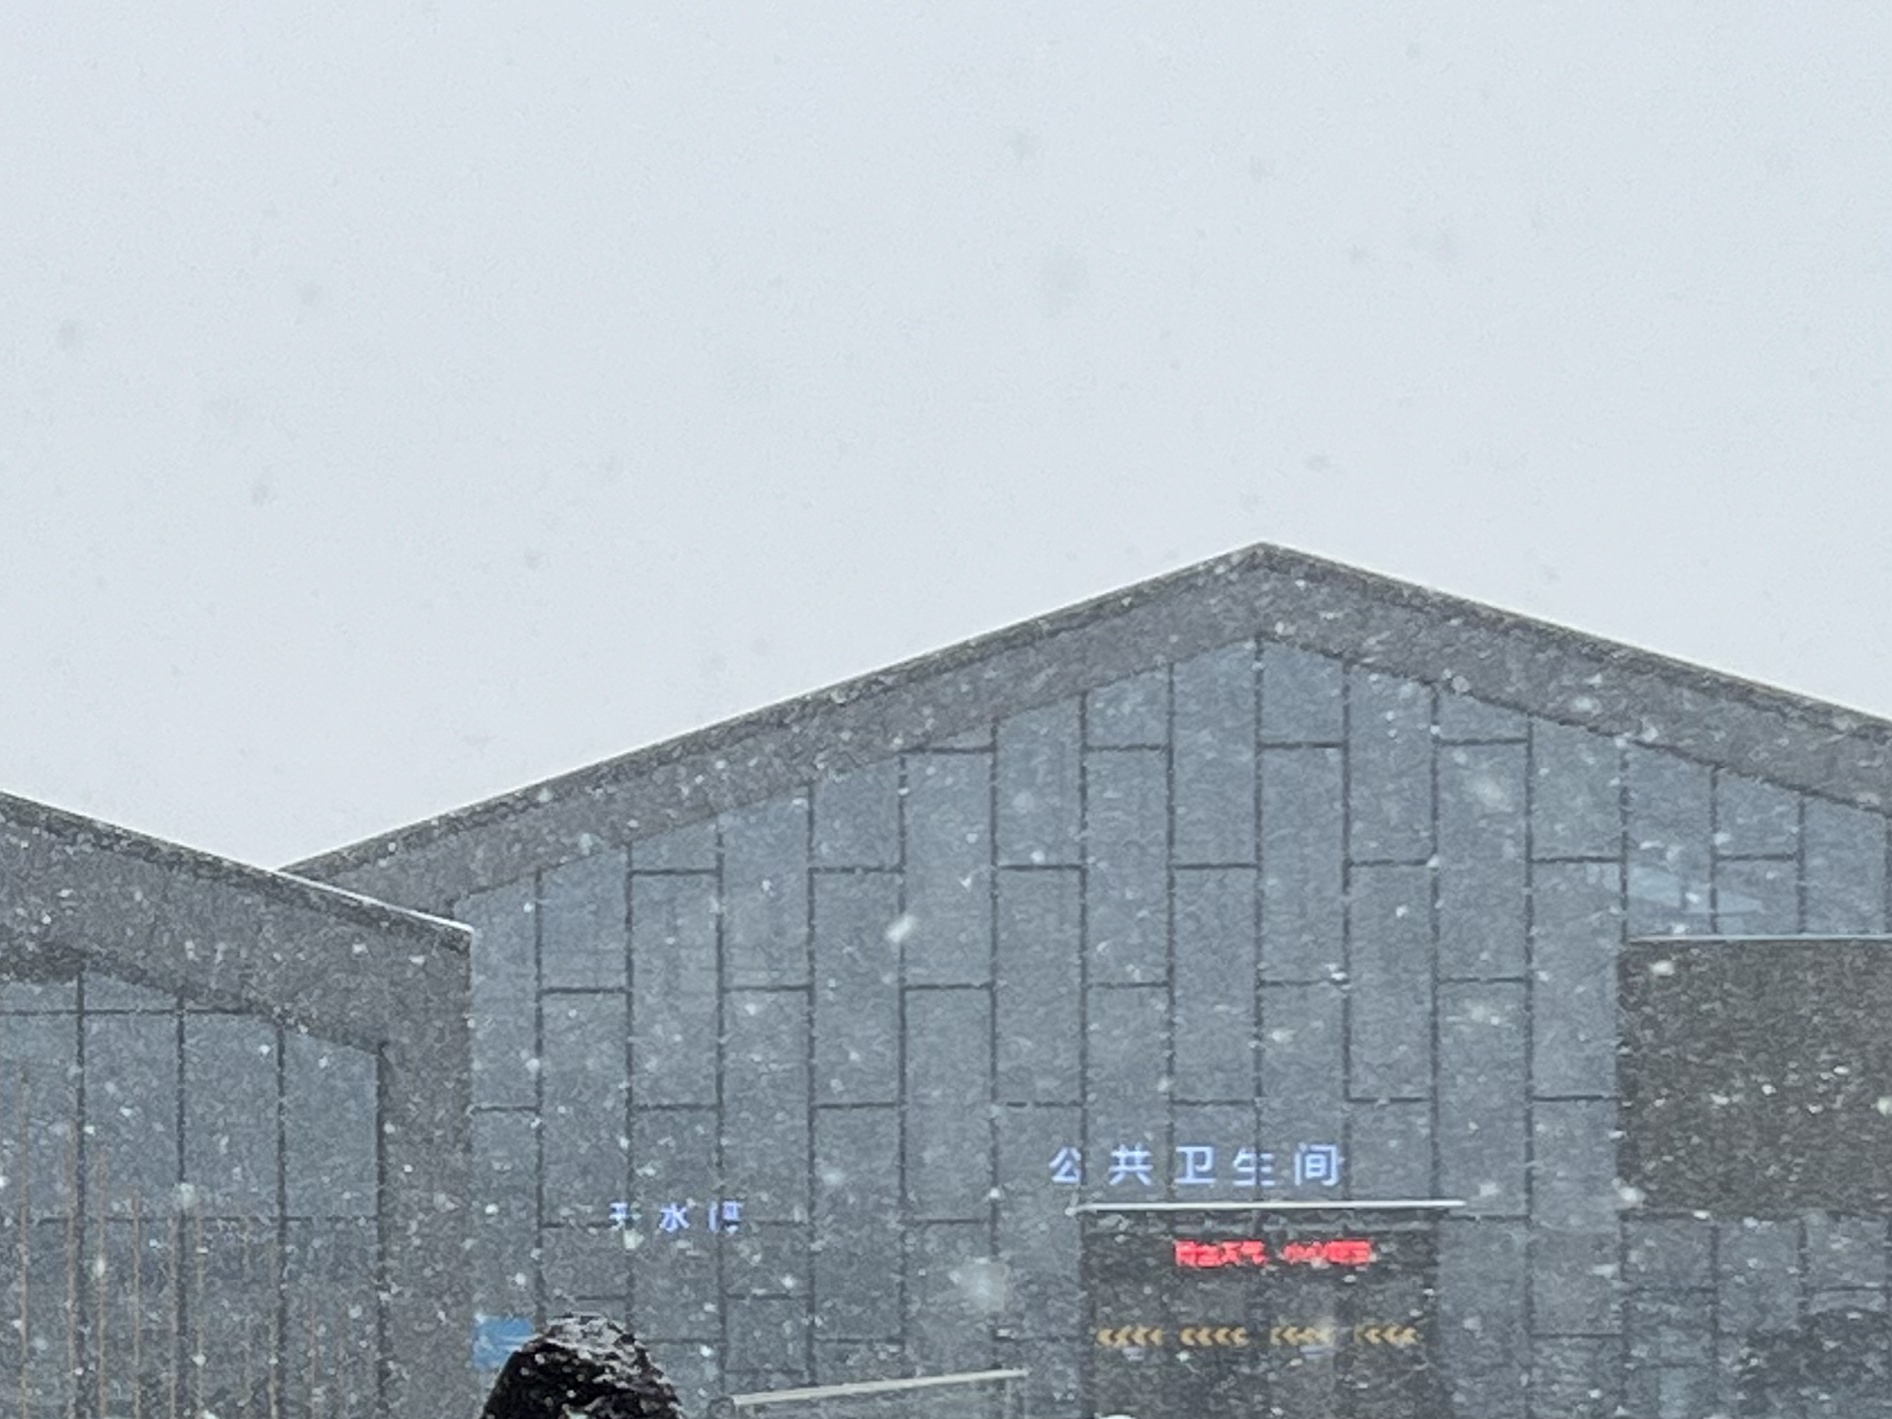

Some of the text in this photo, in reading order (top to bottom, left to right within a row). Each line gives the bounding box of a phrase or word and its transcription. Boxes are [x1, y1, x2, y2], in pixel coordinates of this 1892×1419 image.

[1048, 1142, 1341, 1187] 公共卫生间
